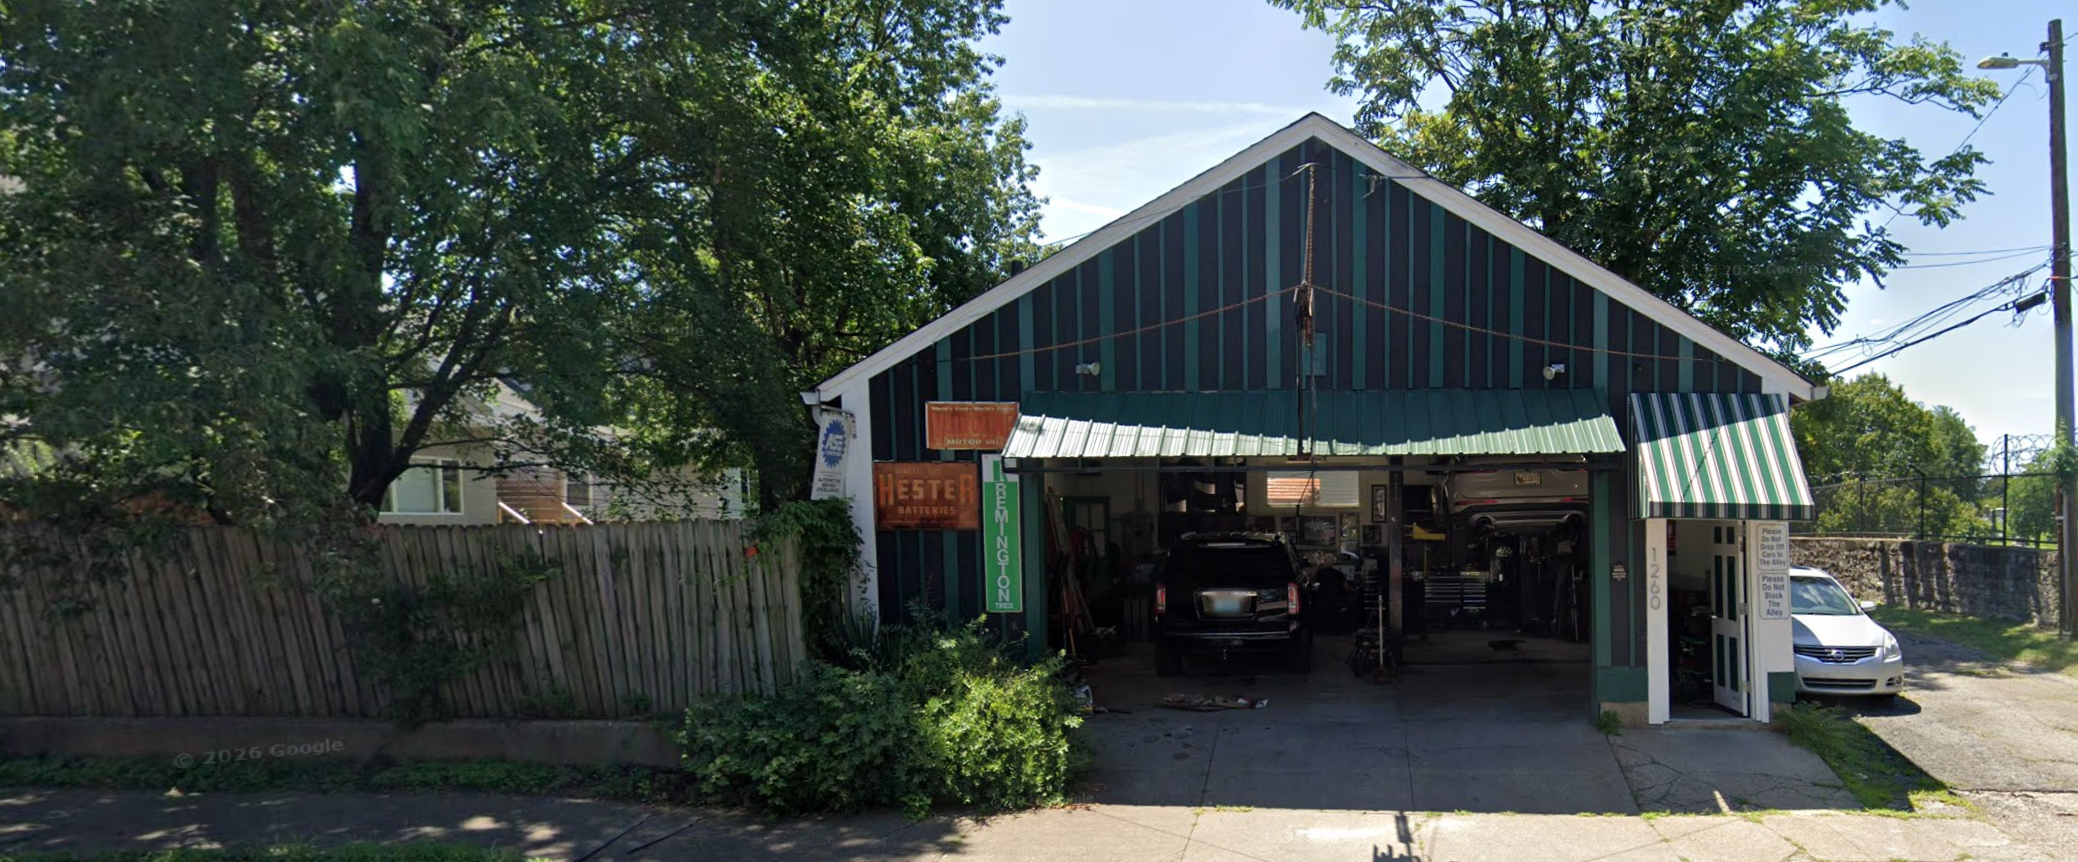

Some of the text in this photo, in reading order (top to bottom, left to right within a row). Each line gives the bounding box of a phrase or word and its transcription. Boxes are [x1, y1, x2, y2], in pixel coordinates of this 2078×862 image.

[878, 473, 974, 507] HESTER
[898, 506, 956, 515] BATTERIES
[995, 483, 1010, 602] REMINGTON
[1772, 559, 1786, 567] Alley
[1650, 547, 1661, 610] 1260
[1766, 609, 1783, 617] Alley
